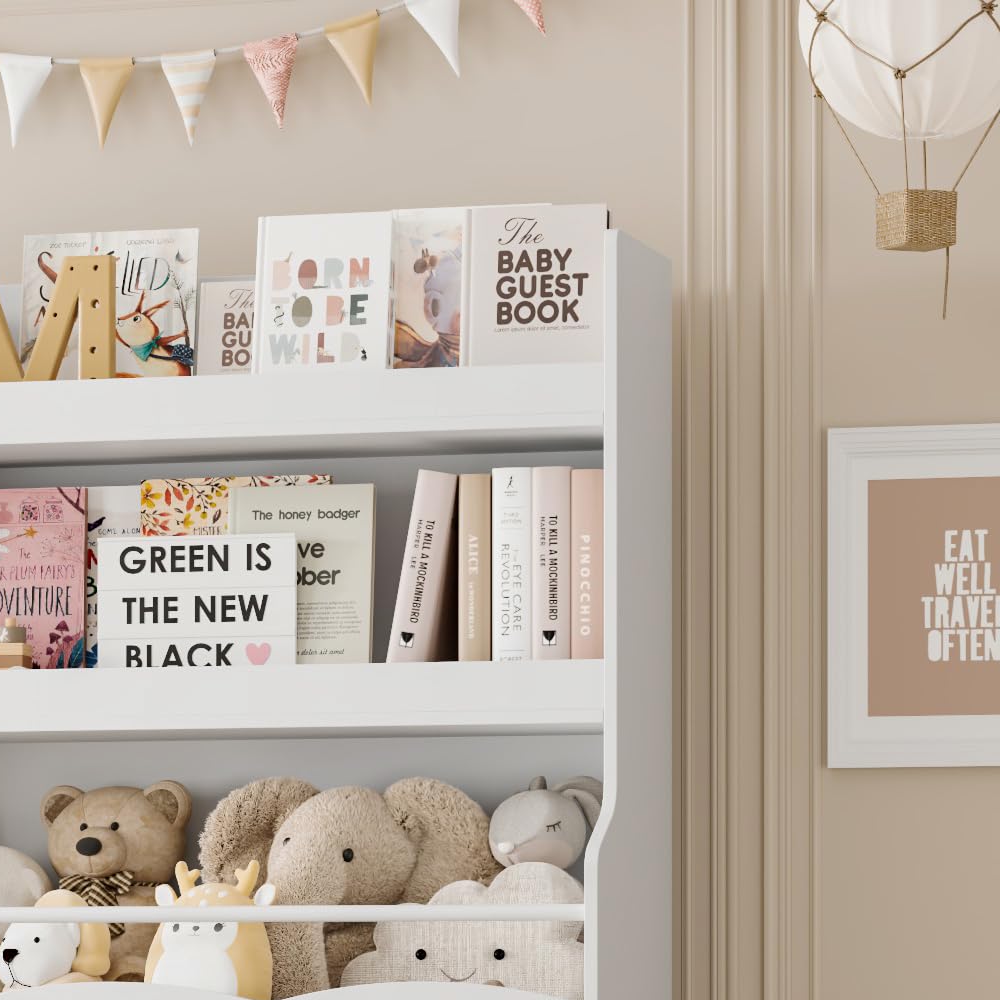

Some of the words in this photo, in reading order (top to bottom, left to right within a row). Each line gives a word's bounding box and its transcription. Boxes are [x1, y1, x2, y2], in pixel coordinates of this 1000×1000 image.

[498, 217, 544, 245] The
[271, 256, 371, 290] BORN
[497, 247, 573, 274] BABY
[496, 272, 589, 299] GUEST
[271, 294, 313, 328] TO
[325, 293, 369, 327] BE
[496, 298, 580, 325] BOOK
[252, 510, 273, 521] The
[278, 509, 312, 522] honey
[317, 508, 361, 522] badger
[425, 520, 435, 531] TO
[549, 515, 558, 526] TO
[121, 527, 140, 535] ALON
[422, 532, 433, 550] KILL
[549, 528, 558, 546] KILL
[19, 547, 31, 559] The
[119, 544, 229, 574] GREEN
[246, 542, 272, 572] IS
[297, 542, 325, 559] ve
[468, 534, 479, 575] ALICE
[944, 529, 989, 562] EAT
[9, 565, 37, 580] PLUM
[512, 564, 522, 588] EYE
[580, 534, 591, 637] PINOCCHIO
[934, 562, 997, 596] WELL
[501, 544, 510, 637] REVOLUTION
[122, 596, 178, 625] THE
[194, 594, 269, 623] NEW
[512, 593, 522, 632] CARE
[126, 643, 234, 668] BLACK
[928, 628, 1000, 662] OFTEN
